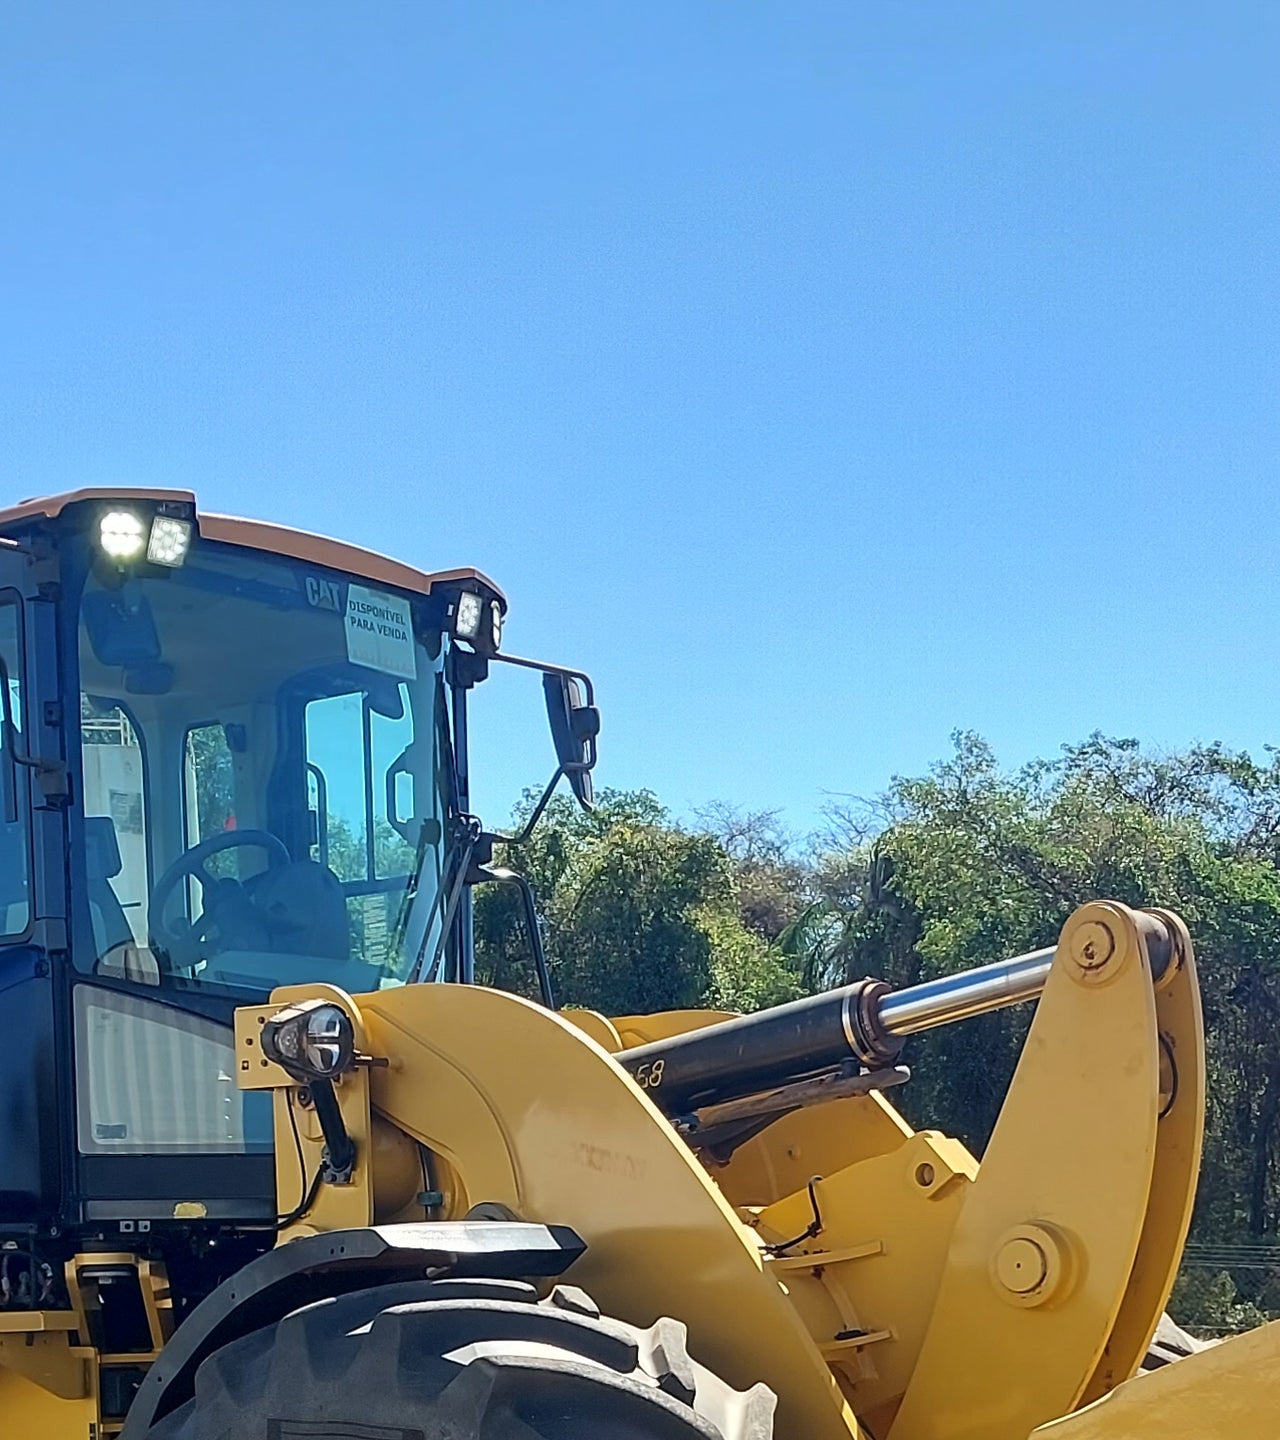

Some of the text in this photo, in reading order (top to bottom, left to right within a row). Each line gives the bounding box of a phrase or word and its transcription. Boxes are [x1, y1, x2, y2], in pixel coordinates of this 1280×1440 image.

[305, 577, 341, 612] CAT
[349, 600, 406, 626] DISPONÍVEL
[350, 616, 408, 643] PARA VENDA
